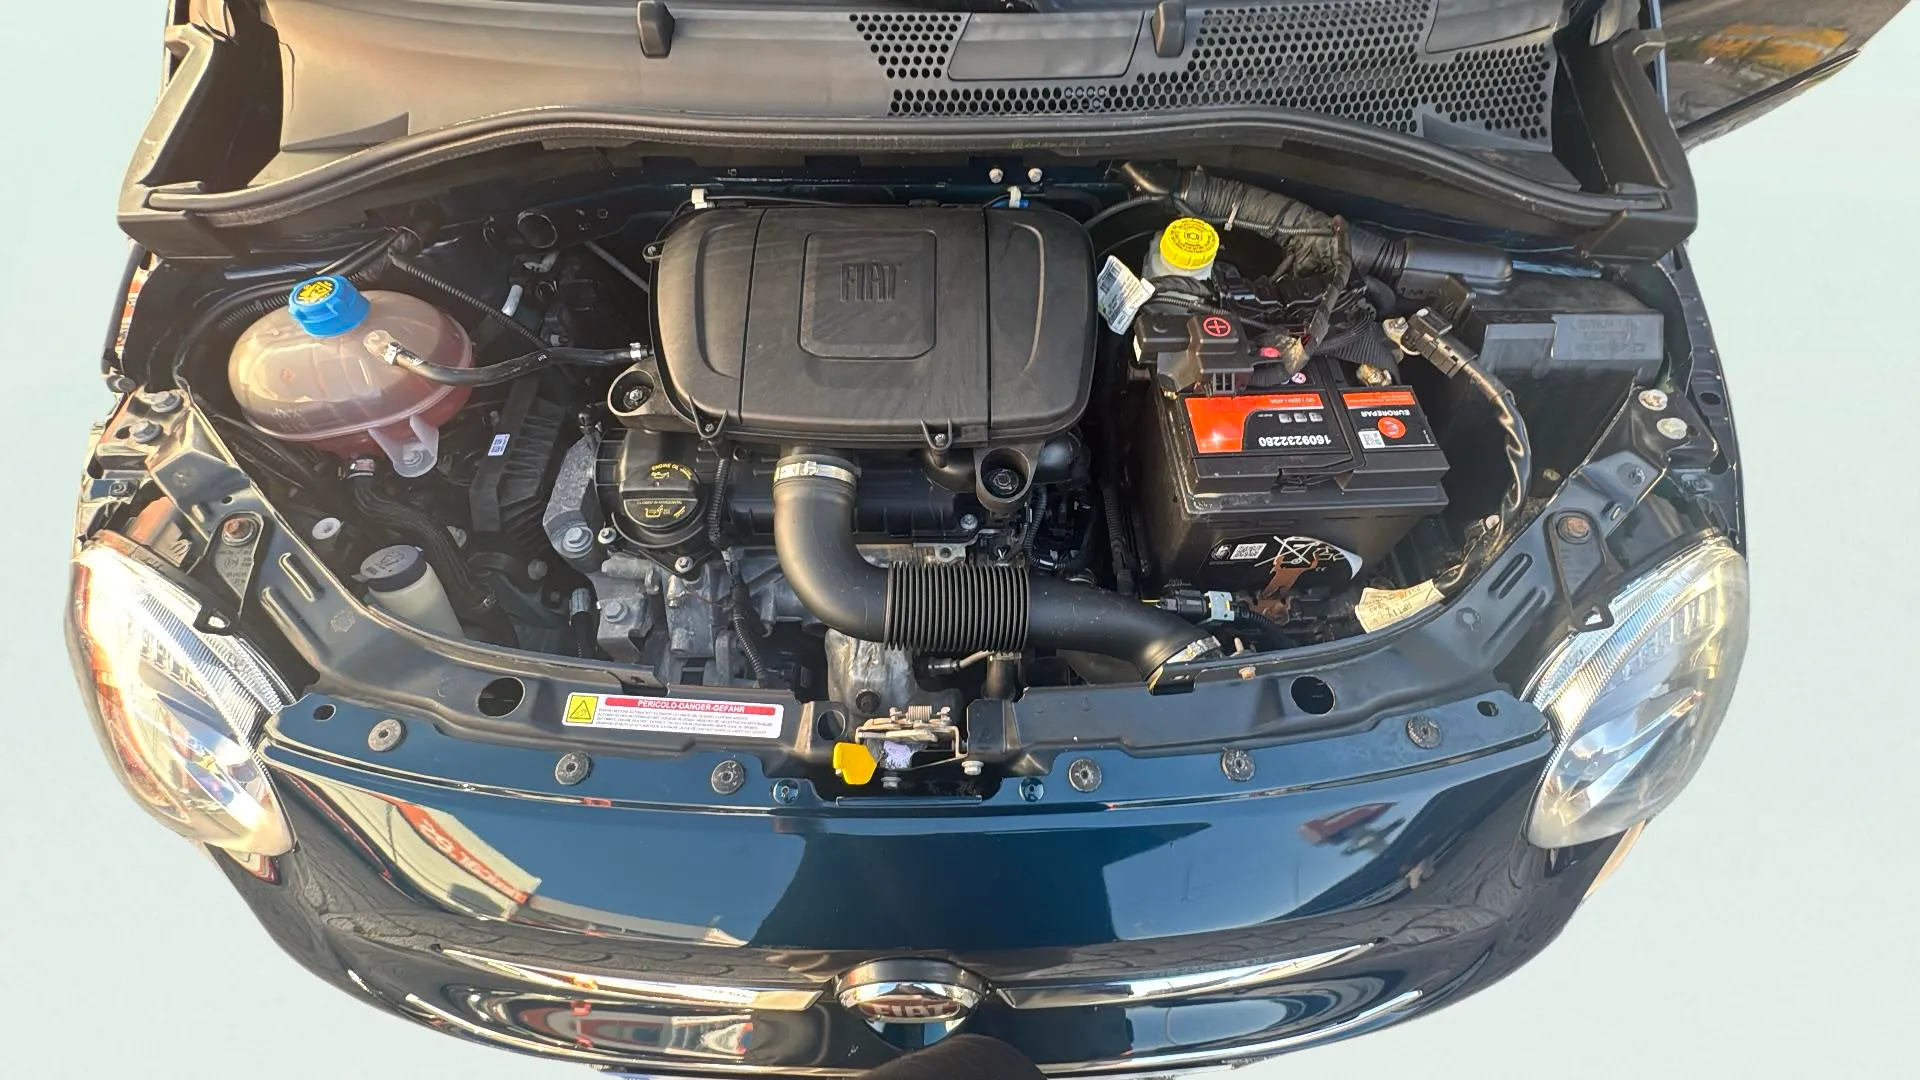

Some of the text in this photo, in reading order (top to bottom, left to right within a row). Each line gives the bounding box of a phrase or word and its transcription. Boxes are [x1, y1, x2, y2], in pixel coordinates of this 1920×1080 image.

[840, 262, 898, 302] FIAT
[1360, 409, 1410, 417] EUROREPAR
[1258, 434, 1331, 447] 1609232280
[637, 699, 745, 713] PERICOLO-DANGER-GEFAHR
[873, 1004, 944, 1017] FIAT
